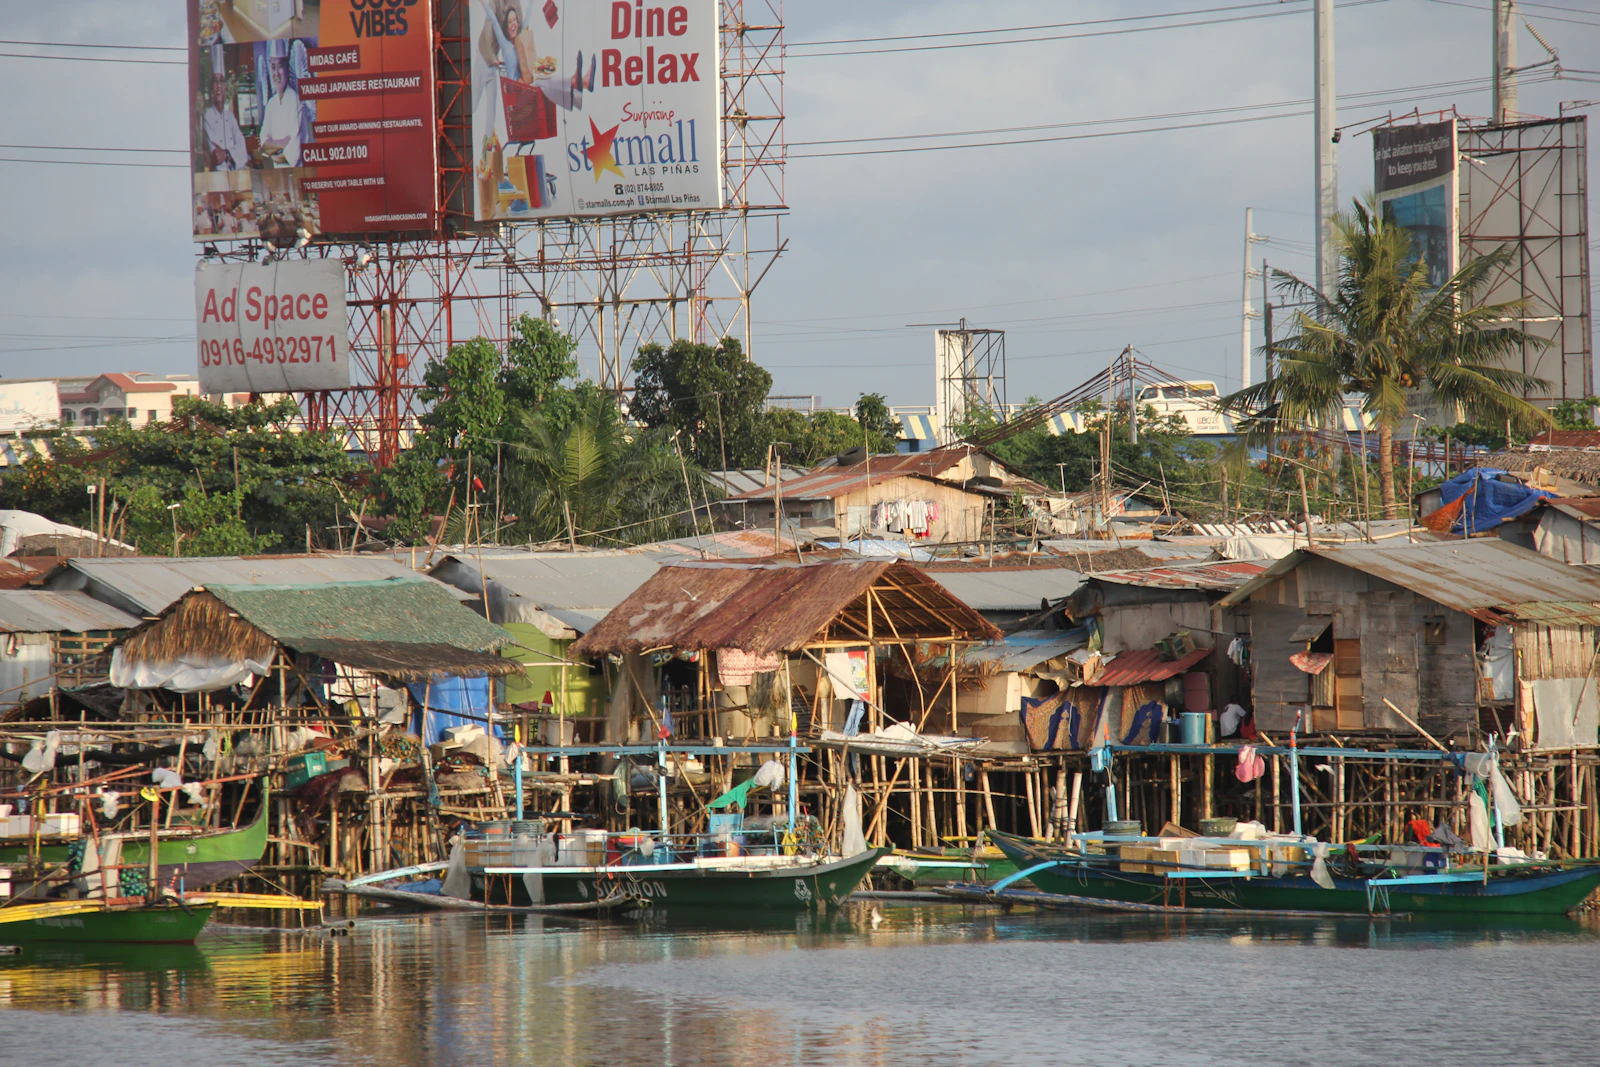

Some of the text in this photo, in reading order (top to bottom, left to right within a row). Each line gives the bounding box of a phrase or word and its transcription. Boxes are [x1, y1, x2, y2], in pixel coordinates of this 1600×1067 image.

[349, 7, 408, 38] VIBES
[611, 0, 688, 40] Dine
[310, 51, 358, 66] MIDAS CAFÉ
[602, 46, 701, 88] Relax
[301, 77, 421, 95] YANAGI JAPANESE RESTAURANT
[621, 101, 674, 128] Surprising
[314, 125, 327, 133] VISIT
[327, 124, 339, 132] OUR
[303, 145, 368, 162] CALL 902.0100
[634, 164, 699, 176] LAS PIÑAS
[1388, 165, 1396, 175] to
[1397, 162, 1412, 175] keep
[303, 182, 311, 190] TO
[311, 180, 333, 189] RESERVE
[334, 179, 347, 187] YOUR
[347, 178, 363, 186] TABLE
[363, 176, 376, 185] WITH
[624, 184, 636, 194] (02)
[585, 198, 635, 209] starmalls.com.ph
[645, 193, 701, 205] Starmall Las Piñas
[202, 286, 328, 330] Ad Space
[201, 334, 337, 367] 0916-4932971
